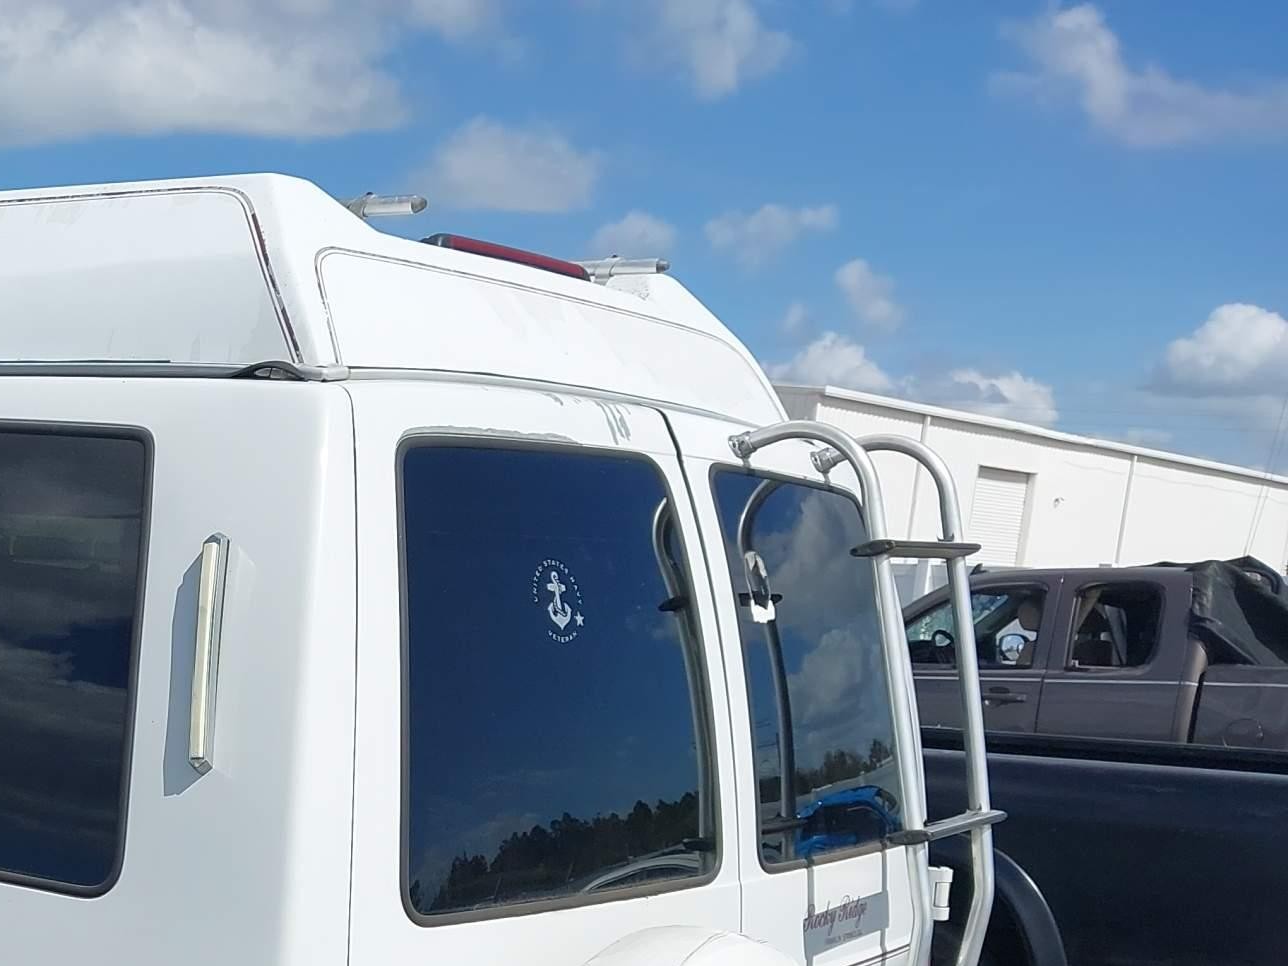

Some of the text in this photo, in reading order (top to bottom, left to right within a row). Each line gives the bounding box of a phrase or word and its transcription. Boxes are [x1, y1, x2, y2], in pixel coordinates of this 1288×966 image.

[542, 559, 569, 575] STATES
[548, 629, 578, 643] VETERAN
[803, 900, 837, 936] Rocky
[839, 895, 868, 928] Ridge
